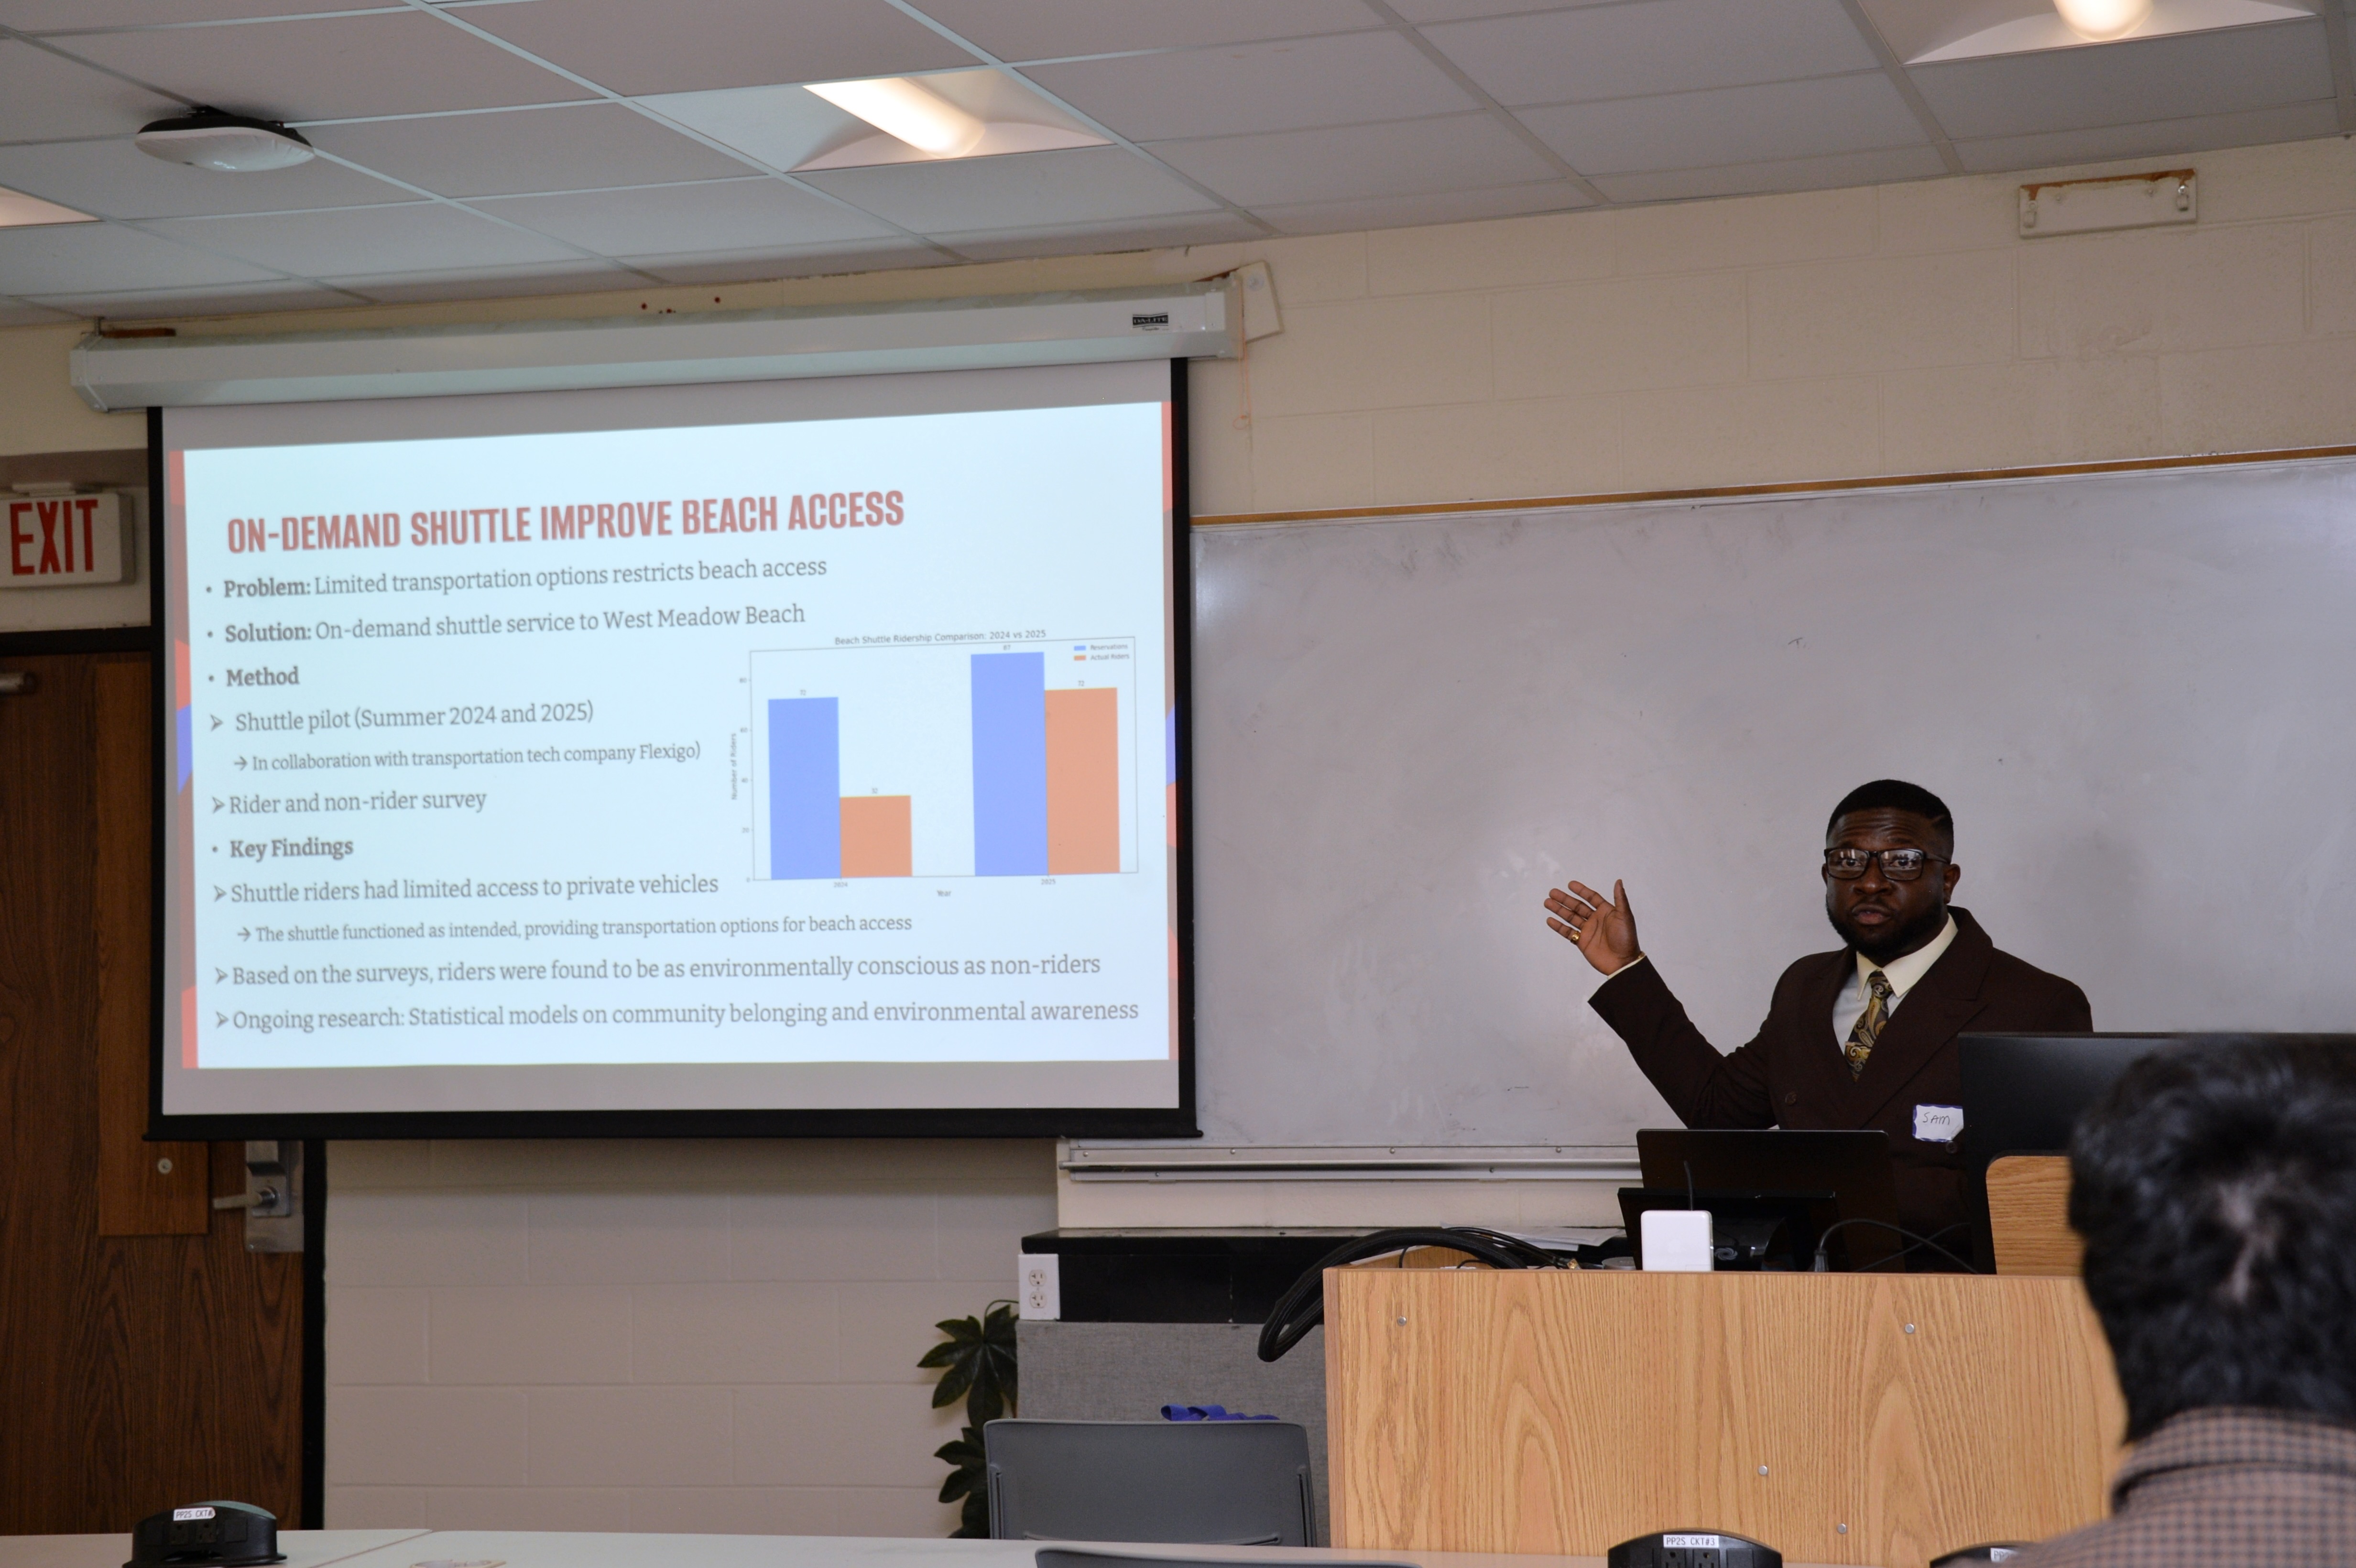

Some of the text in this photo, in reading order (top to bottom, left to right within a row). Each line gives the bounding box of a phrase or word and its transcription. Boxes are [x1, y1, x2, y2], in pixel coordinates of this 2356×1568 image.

[228, 490, 904, 554] ON-DEMAND SHUTTLE IMPROVE BEACH ACCESS
[10, 500, 98, 575] EXIT
[224, 559, 827, 598] Problem: Limited transportation options restricts beach access
[226, 603, 805, 642] Solution: On-demand shuttle service to West Meadow Beach
[835, 637, 860, 645] Beach
[862, 636, 891, 644] Shuttle
[894, 634, 932, 642] Ridership
[935, 633, 984, 642] Comparison:
[990, 632, 1010, 640] 2024
[1025, 630, 1046, 638] 2025
[227, 666, 299, 686] Method
[236, 699, 593, 734] Shuttle pilot (Summer 2024 and 2025)
[253, 741, 700, 771] In collaboration with transportation tech company Flexigo)
[230, 791, 487, 814] Rider and non-rider survey
[230, 837, 353, 862] Key Findings
[232, 873, 718, 902] Shuttle riders had limited access to private vehicles
[256, 915, 912, 941] The shuttle functioned as intended, providing transportation options for beach access
[233, 954, 1100, 986] Based on the surveys, riders were found to be as environmentally conscious as non-riders
[233, 1001, 1138, 1034] Ongoing research: Statistical models on community belonging and environmental awareness
[1922, 1111, 1951, 1125] SAM
[175, 1510, 192, 1519] PP2S
[1666, 1537, 1715, 1546] PP2S CKT#3
